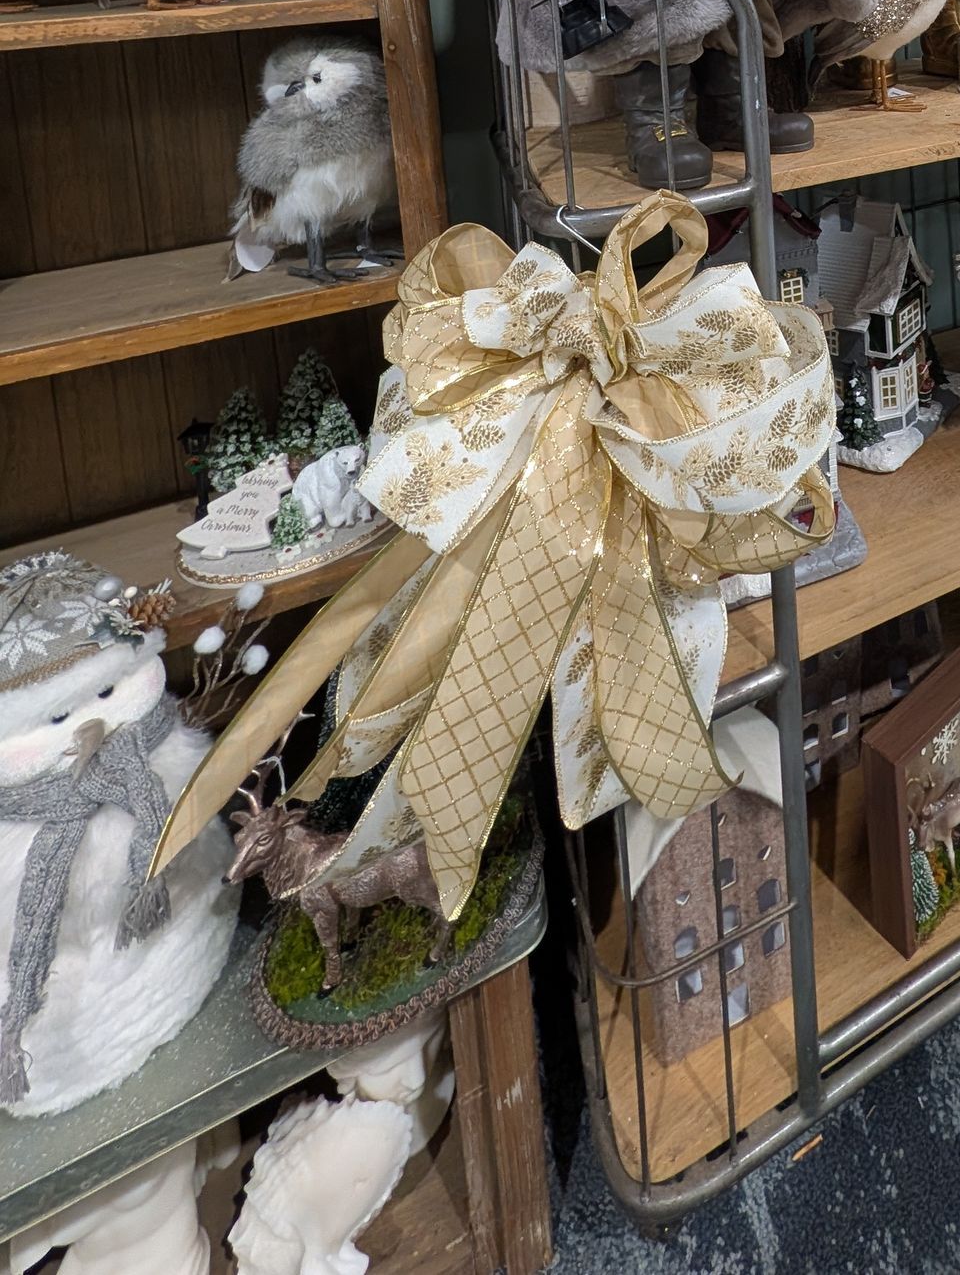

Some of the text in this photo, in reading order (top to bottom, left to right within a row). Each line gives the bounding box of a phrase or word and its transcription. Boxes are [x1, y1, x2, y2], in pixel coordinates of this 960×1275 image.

[242, 475, 279, 489] Wishing
[240, 491, 259, 502] you
[226, 505, 259, 520] Merry
[201, 519, 252, 533] Christmas
